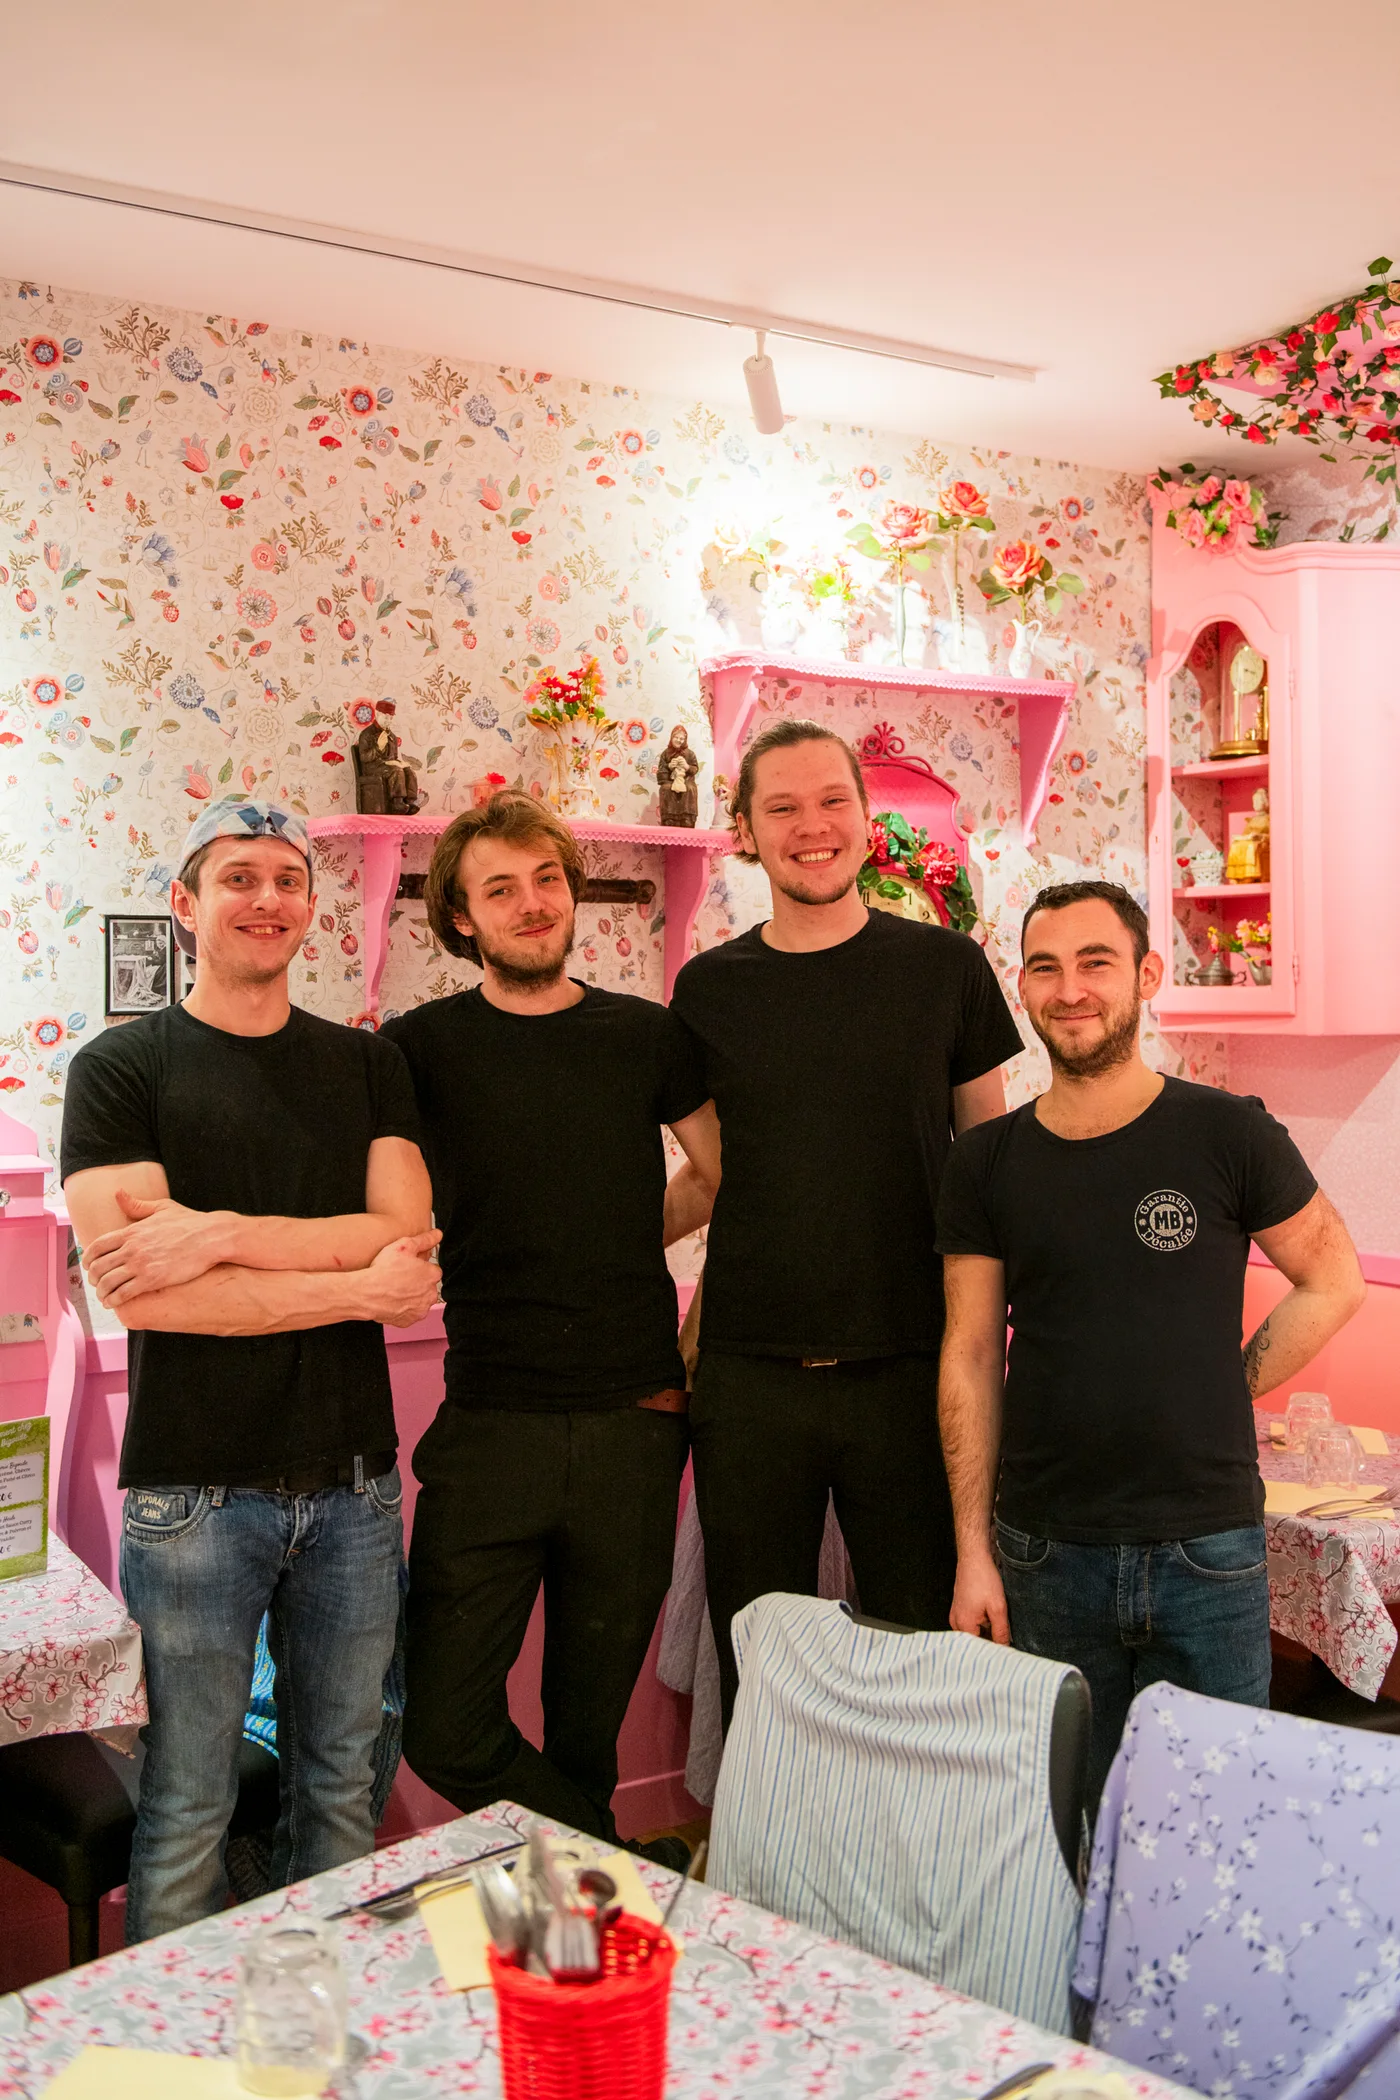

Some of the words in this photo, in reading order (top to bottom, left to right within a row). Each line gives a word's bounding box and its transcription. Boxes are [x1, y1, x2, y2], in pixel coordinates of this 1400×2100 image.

[908, 893, 912, 905] 1
[922, 910, 931, 923] 2
[1140, 1194, 1189, 1214] Garantie
[1154, 1210, 1181, 1230] MB
[1141, 1228, 1193, 1249] Décalée
[141, 1507, 161, 1519] JEANS
